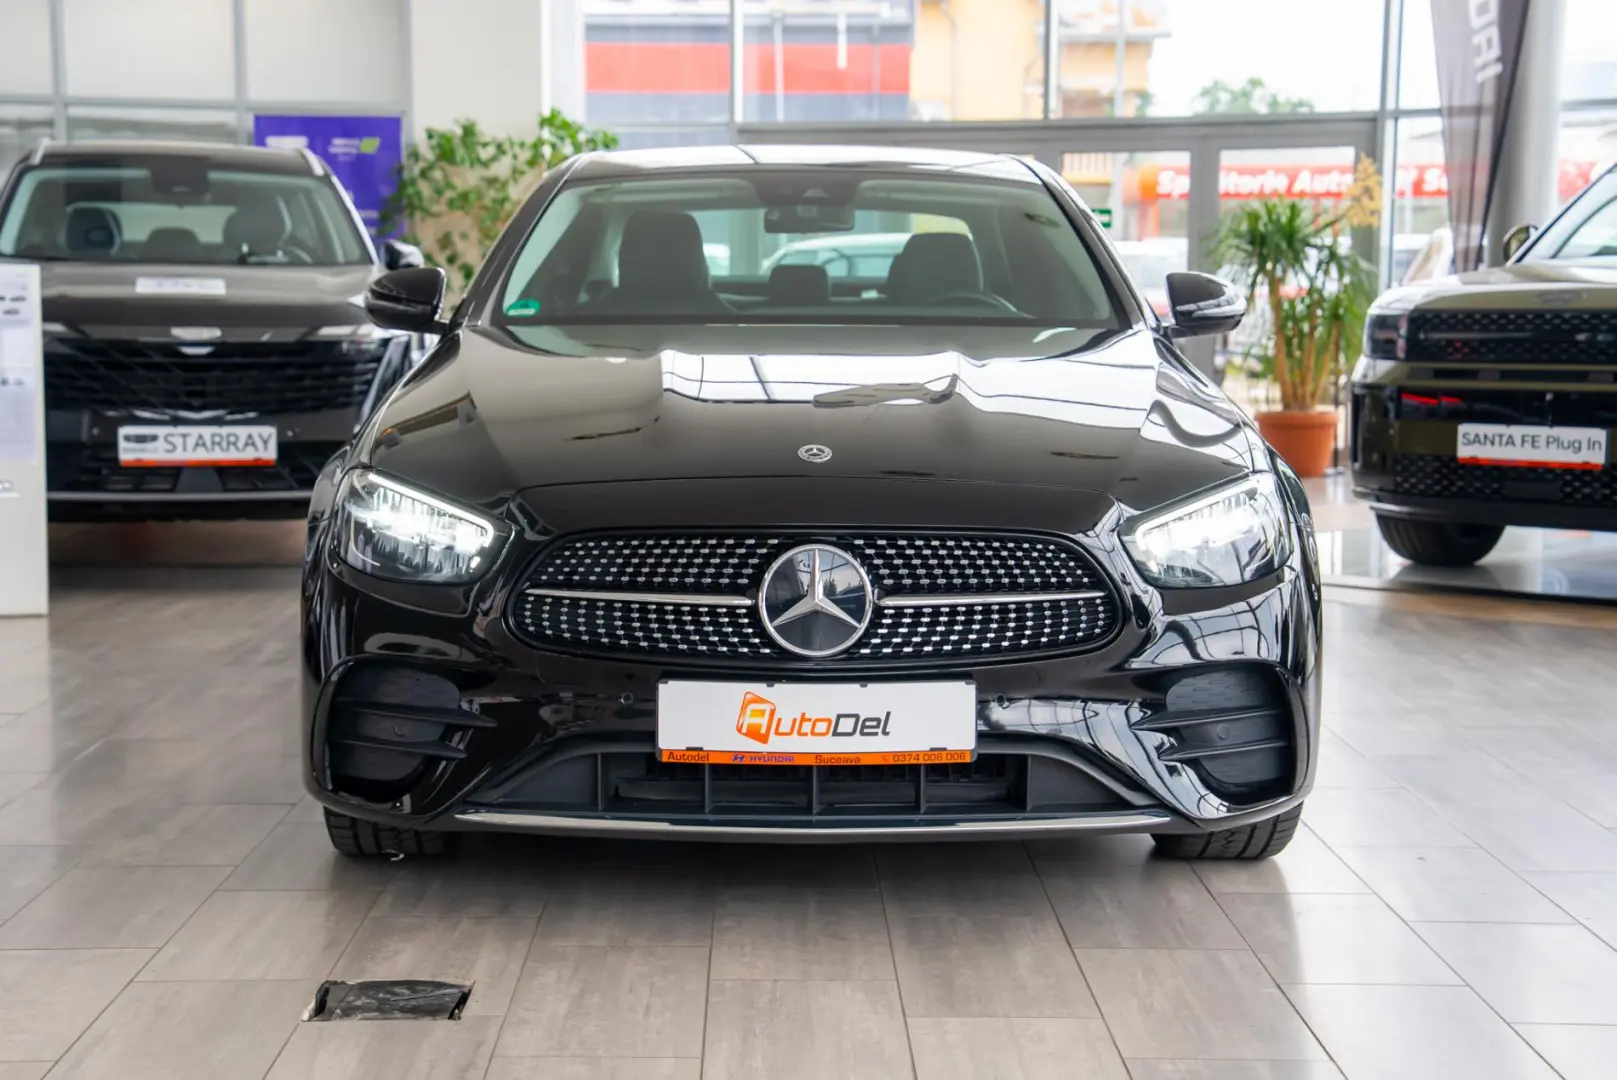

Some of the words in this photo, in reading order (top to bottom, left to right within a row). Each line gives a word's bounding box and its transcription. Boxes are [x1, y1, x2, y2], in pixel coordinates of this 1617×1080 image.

[163, 432, 272, 453] STARRAY
[1461, 432, 1516, 448] SANTA
[1520, 434, 1541, 449] FE
[1546, 435, 1582, 454] Plug
[1587, 437, 1603, 451] In
[740, 701, 892, 738] AutoDel
[667, 751, 709, 762] Autodel
[814, 754, 861, 764] Suceava
[892, 753, 920, 763] 0374
[922, 752, 943, 762] 006
[945, 751, 966, 761] 006
